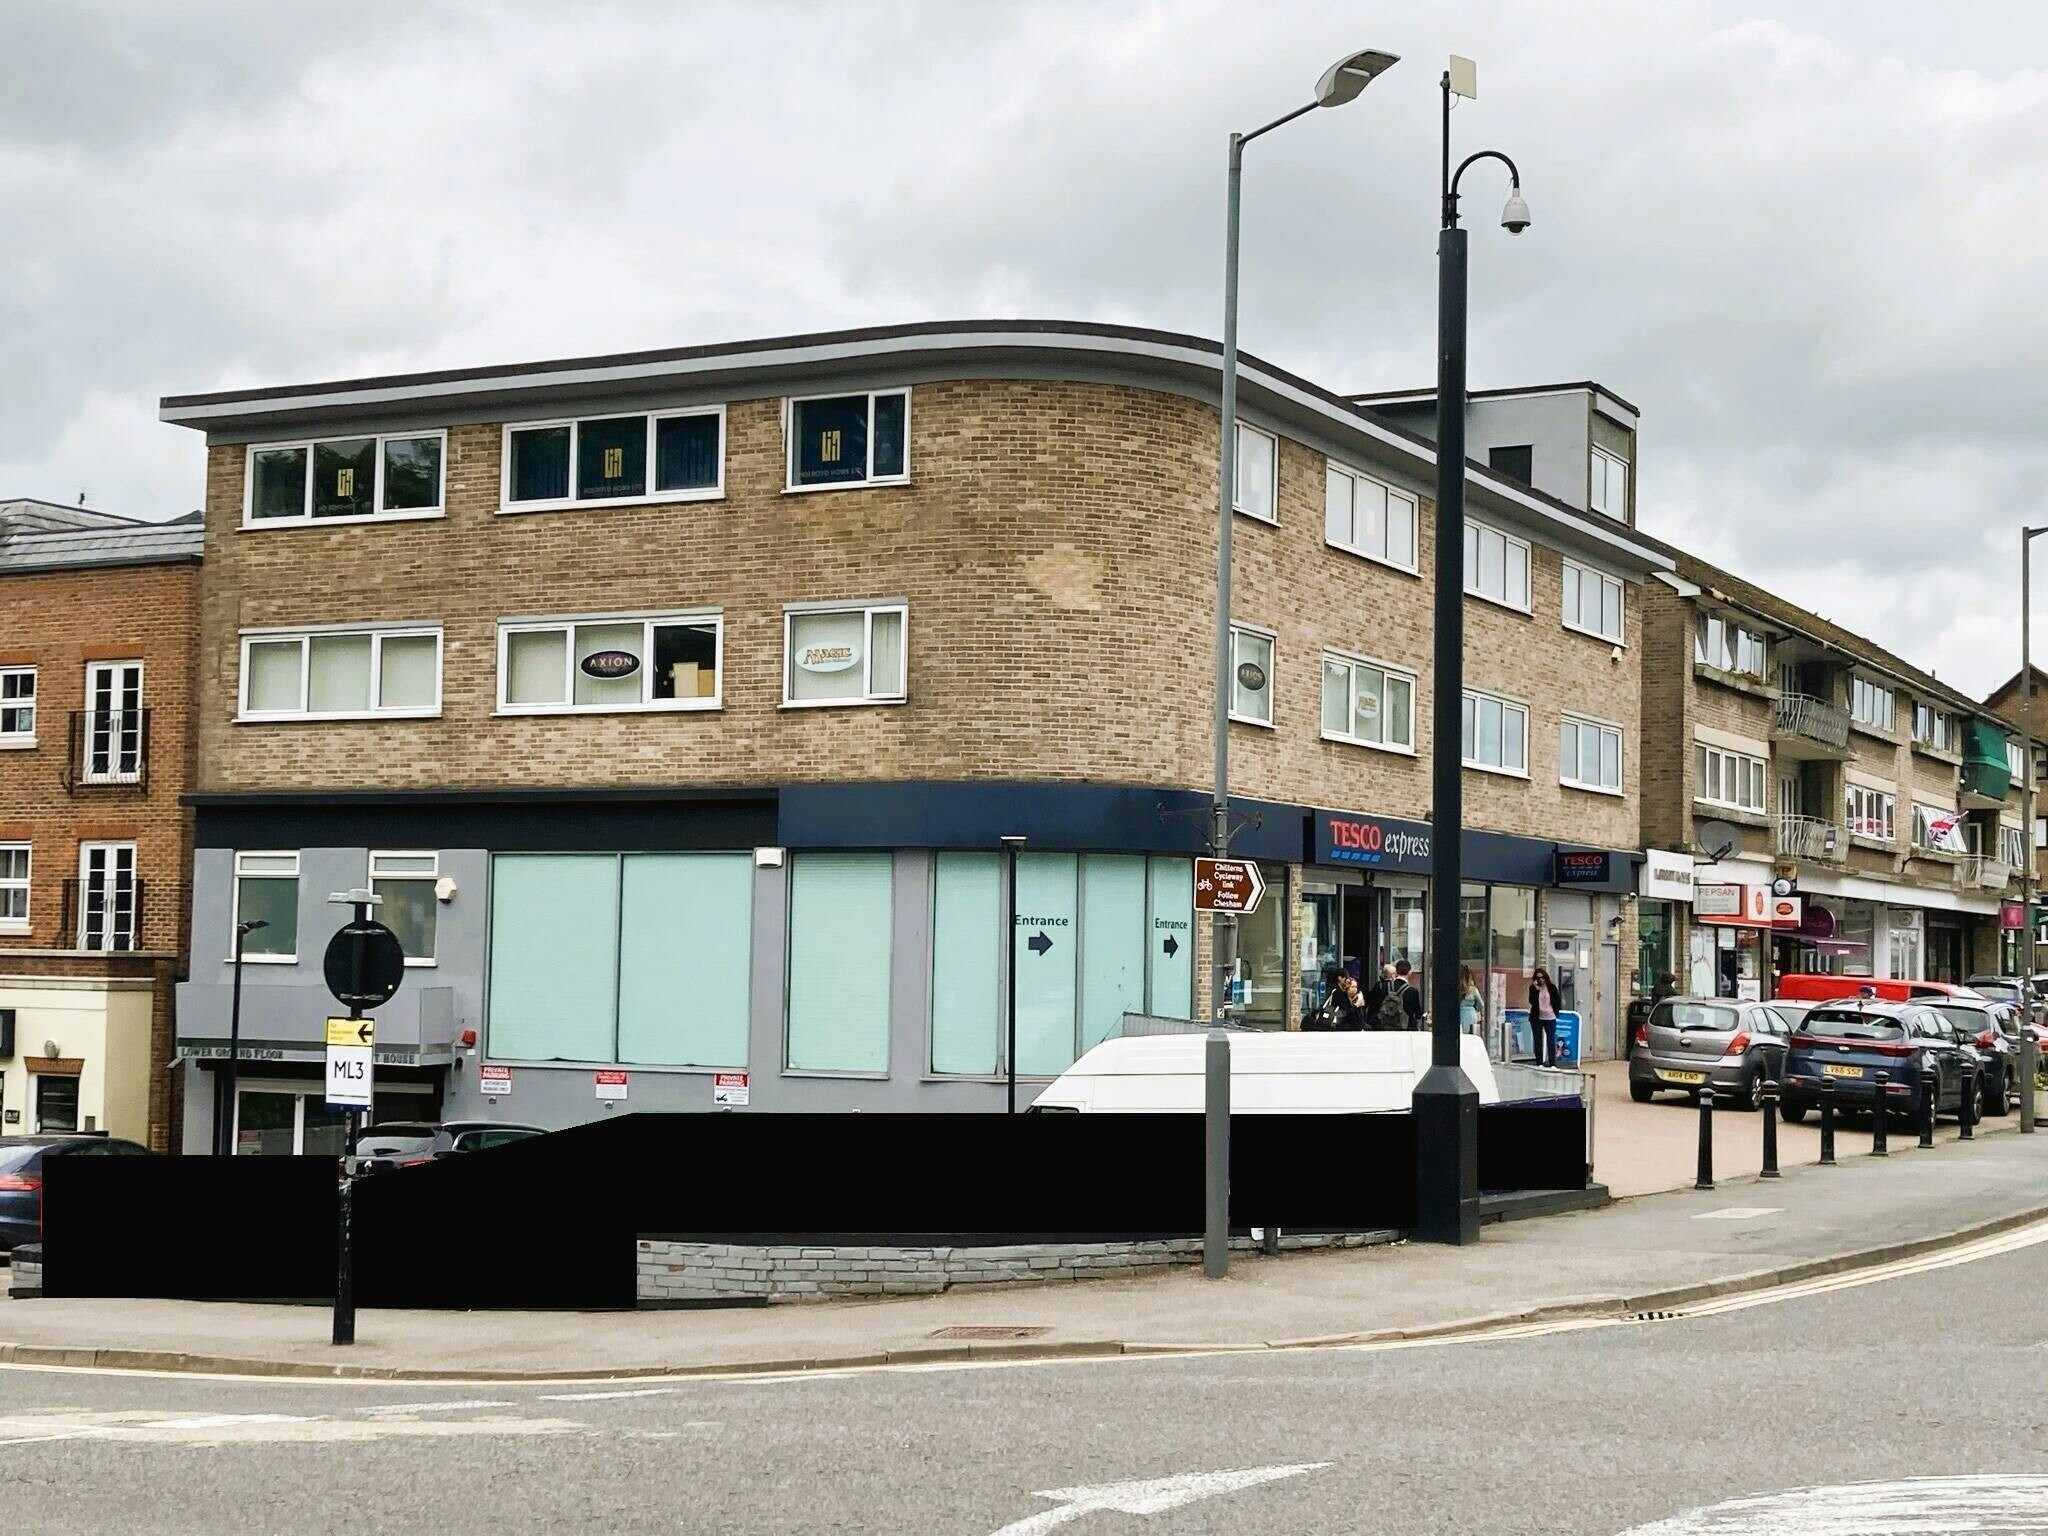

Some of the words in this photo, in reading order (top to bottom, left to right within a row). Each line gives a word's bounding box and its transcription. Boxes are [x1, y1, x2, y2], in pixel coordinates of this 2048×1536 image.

[590, 657, 633, 667] AXION
[1330, 821, 1381, 850] TESCO
[1384, 831, 1430, 862] express
[1564, 855, 1603, 866] TESCO
[1214, 862, 1244, 873] Chilterns
[1213, 871, 1244, 882] Cycleway
[1566, 869, 1598, 878] express
[1217, 890, 1239, 900] Follow
[1213, 898, 1243, 908] Chesham
[1015, 914, 1069, 927] Entrance
[1155, 917, 1188, 930] Entrance
[181, 1047, 213, 1057] LOWER
[215, 1047, 253, 1058] GROND
[254, 1049, 284, 1060] FLOOR
[383, 1053, 416, 1065] HOUSE
[334, 1060, 364, 1079] ML3
